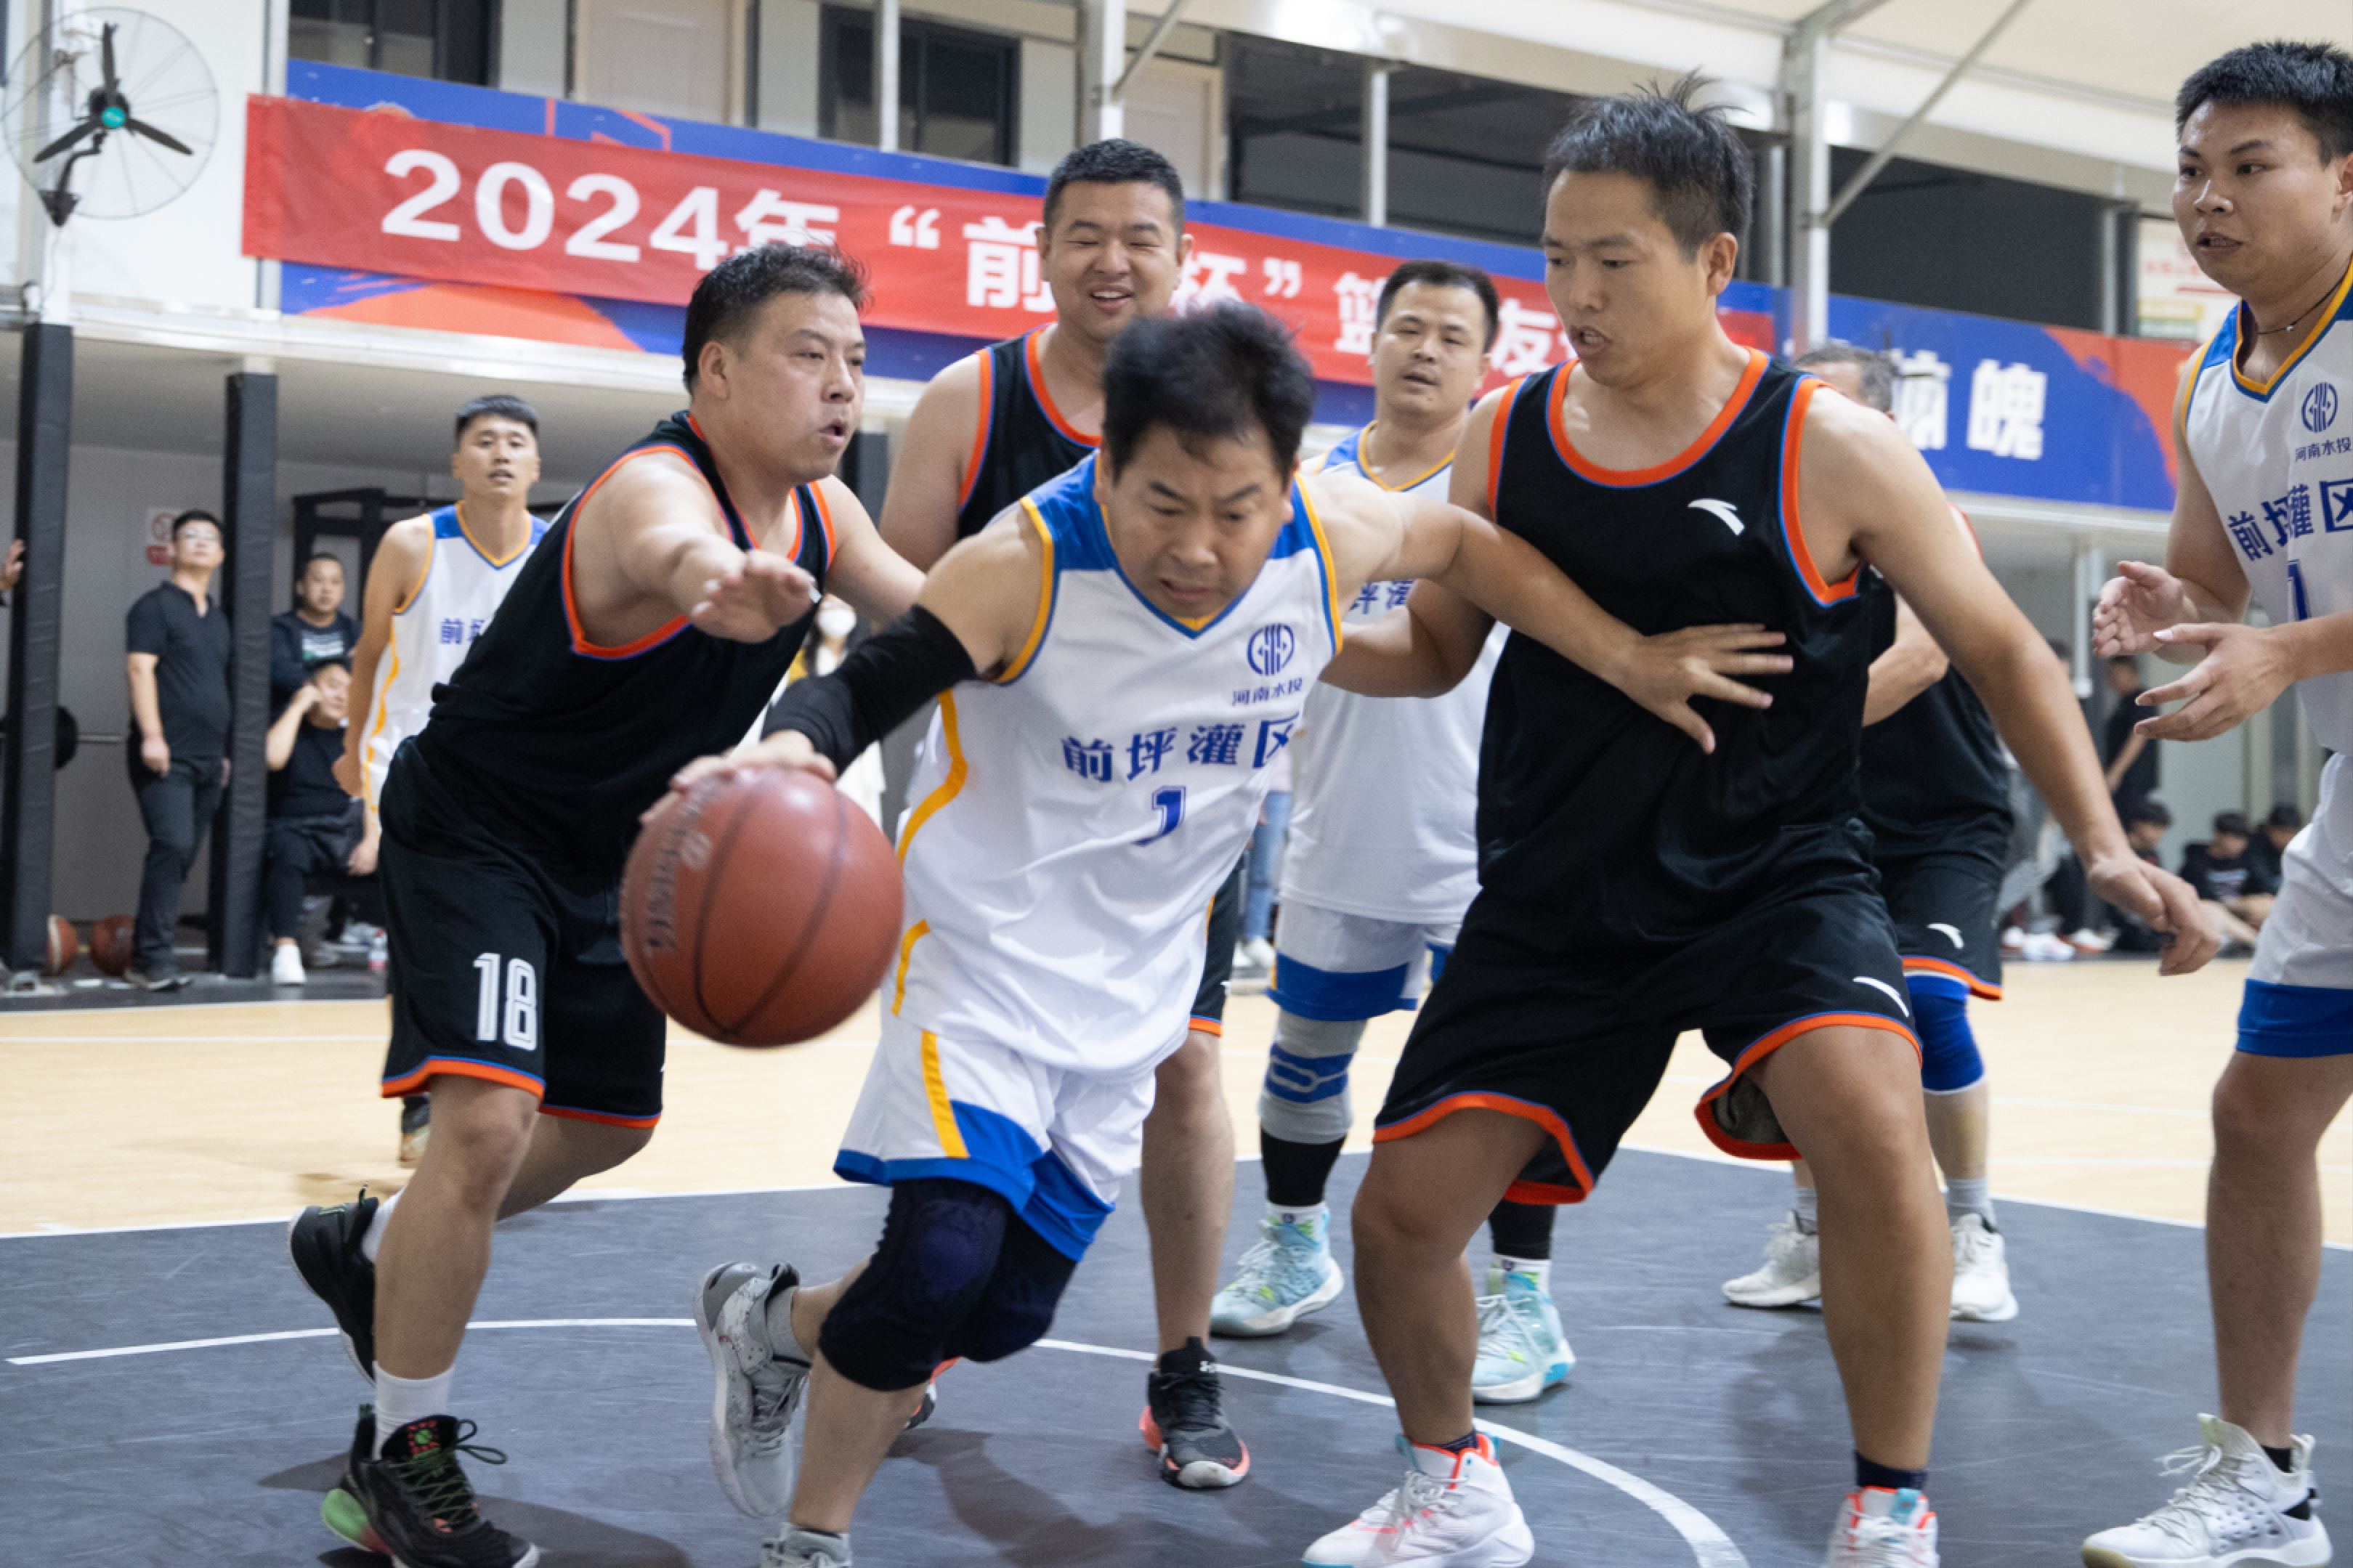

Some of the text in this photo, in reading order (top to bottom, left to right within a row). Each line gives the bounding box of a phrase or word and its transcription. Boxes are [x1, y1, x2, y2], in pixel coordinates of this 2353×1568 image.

[2294, 436, 2352, 463] 河南水投
[1231, 677, 1303, 706] 河南水投
[1061, 711, 1300, 782] 前坪灌区
[1130, 786, 1186, 847] 1
[473, 952, 538, 1052] 18
